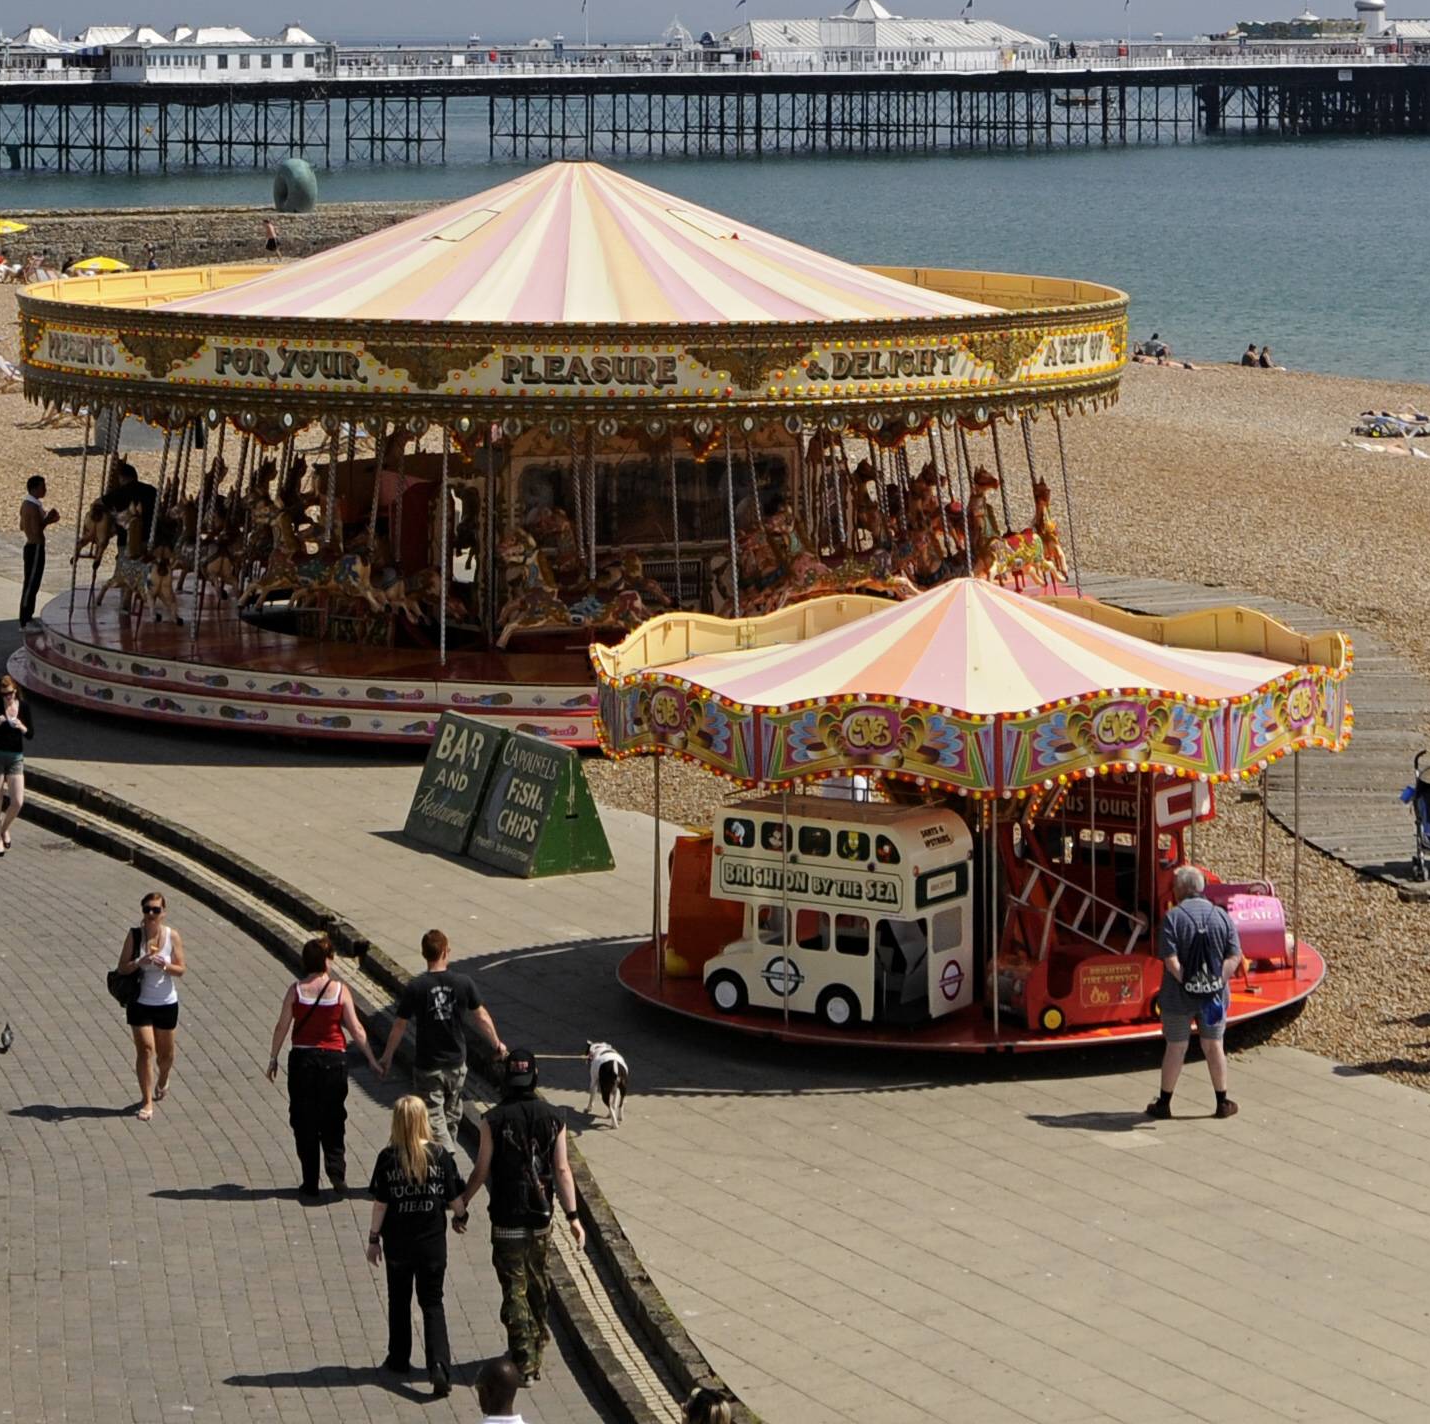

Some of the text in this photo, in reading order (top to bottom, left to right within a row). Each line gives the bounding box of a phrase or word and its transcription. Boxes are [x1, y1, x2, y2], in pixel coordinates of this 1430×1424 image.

[213, 344, 369, 385] FOR YOUR
[500, 354, 679, 390] PLEASURE
[830, 345, 957, 381] DELIGHT
[435, 723, 485, 771] BAR
[434, 767, 469, 792] AND
[1065, 795, 1084, 813] US
[723, 862, 898, 905] BRIGHTON BY THE SEA
[398, 1200, 434, 1213] HEAD
